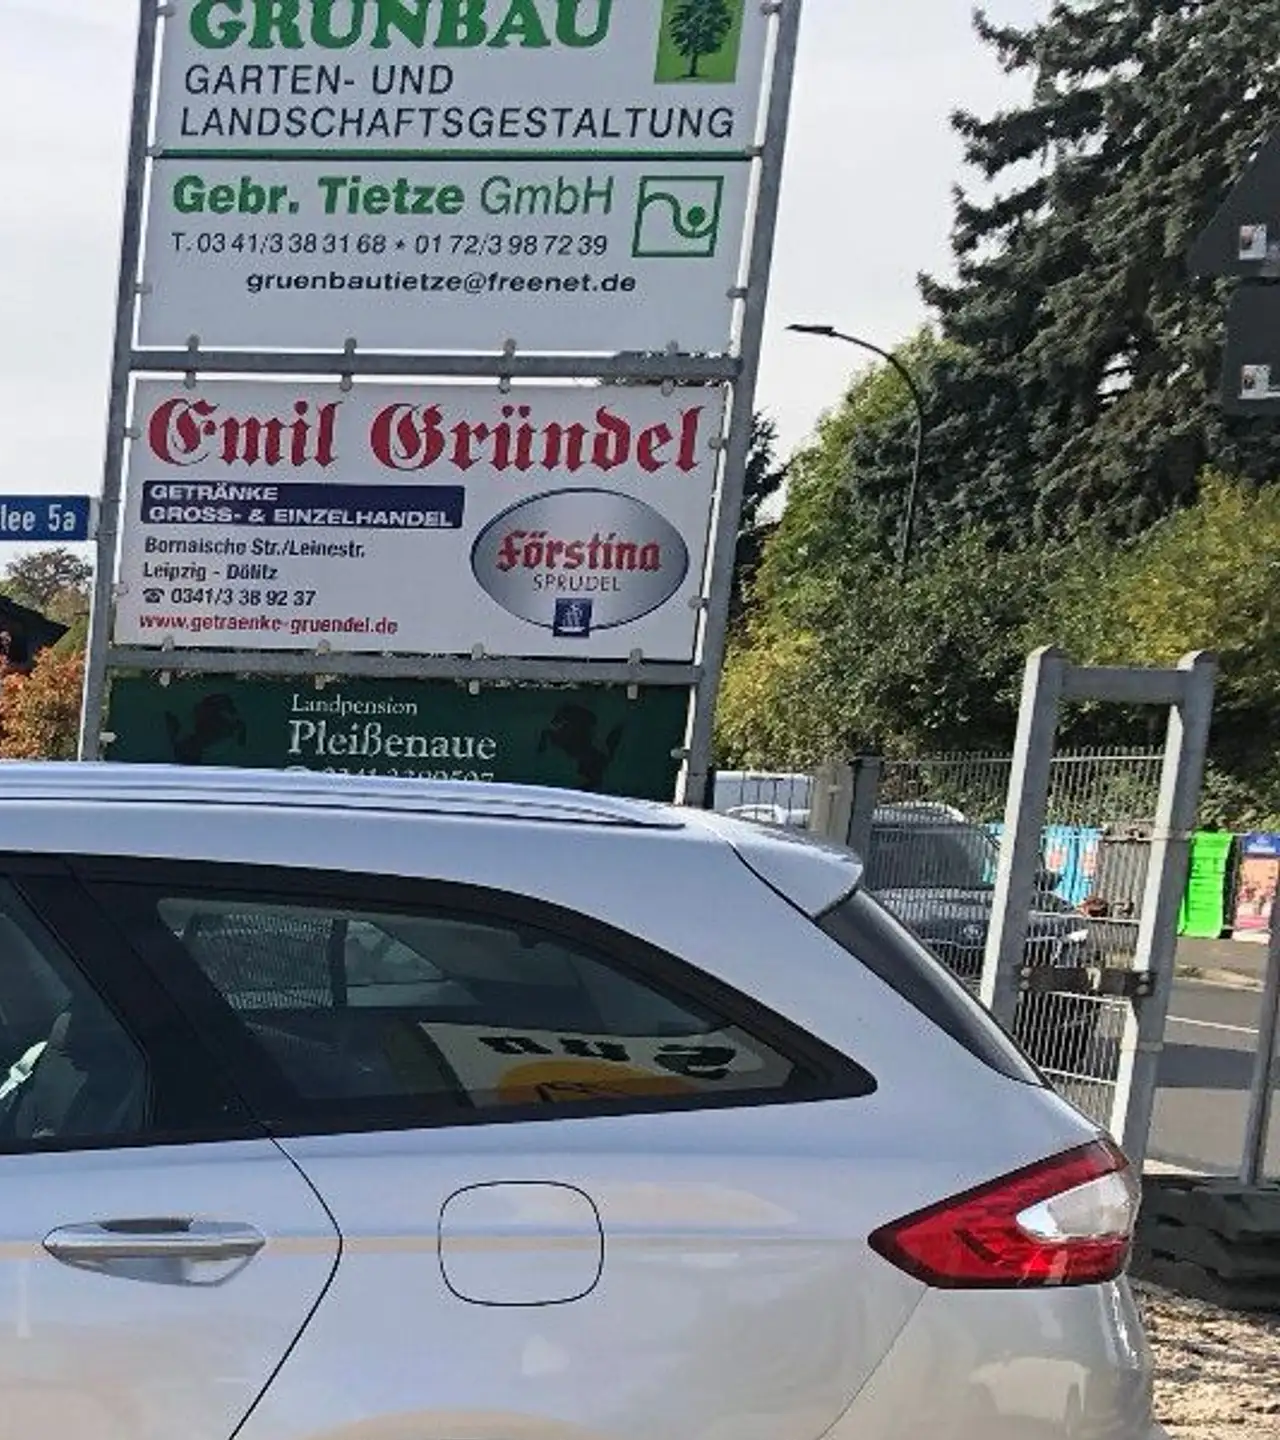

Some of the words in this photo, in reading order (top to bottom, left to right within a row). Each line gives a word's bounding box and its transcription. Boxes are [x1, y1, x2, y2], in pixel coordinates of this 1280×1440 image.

[185, 64, 355, 95] GARTEN-
[372, 64, 453, 95] UND
[181, 106, 734, 138] LANDSCHAFTSGESTALTUNG
[172, 175, 299, 215] Gebr.
[317, 175, 465, 215] Tietze
[480, 175, 614, 215] GmbH
[246, 271, 636, 294] gruenbautietze@freenet.de
[148, 397, 344, 467] Emil
[370, 401, 706, 473] Gründel
[149, 482, 278, 501] GETRÄNKE
[48, 503, 76, 532] 5a
[149, 506, 240, 524] GROSS-
[248, 507, 266, 524] &
[272, 508, 454, 528] EINZELHANDEL
[495, 529, 662, 573] Förstina
[143, 561, 206, 583] Leipzig
[226, 562, 278, 581] Dölitz
[533, 573, 621, 592] SPRUDEL
[291, 693, 418, 717] Landpension
[287, 719, 497, 760] Pleißenaue
